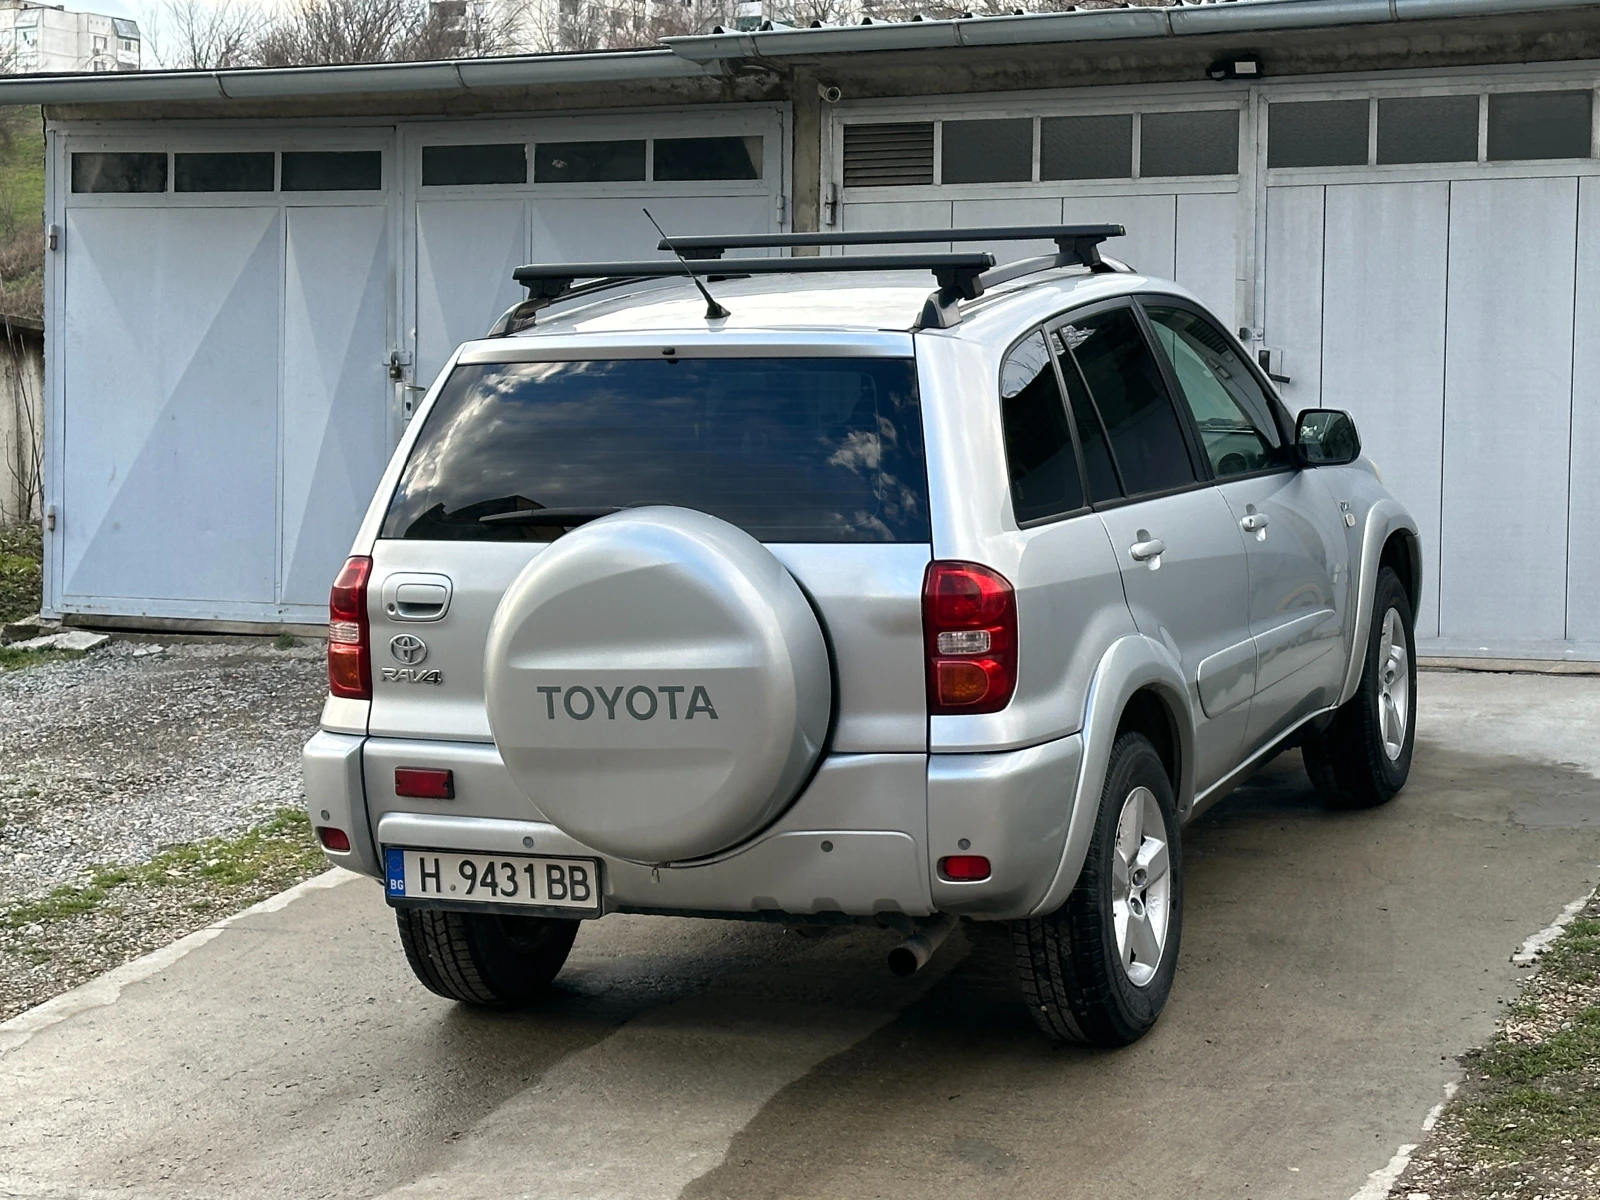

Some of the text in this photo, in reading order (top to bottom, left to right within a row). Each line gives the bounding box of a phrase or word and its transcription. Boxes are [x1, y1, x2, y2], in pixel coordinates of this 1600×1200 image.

[381, 667, 442, 684] RAV4
[536, 685, 719, 721] TOYOTA
[390, 879, 404, 890] BG
